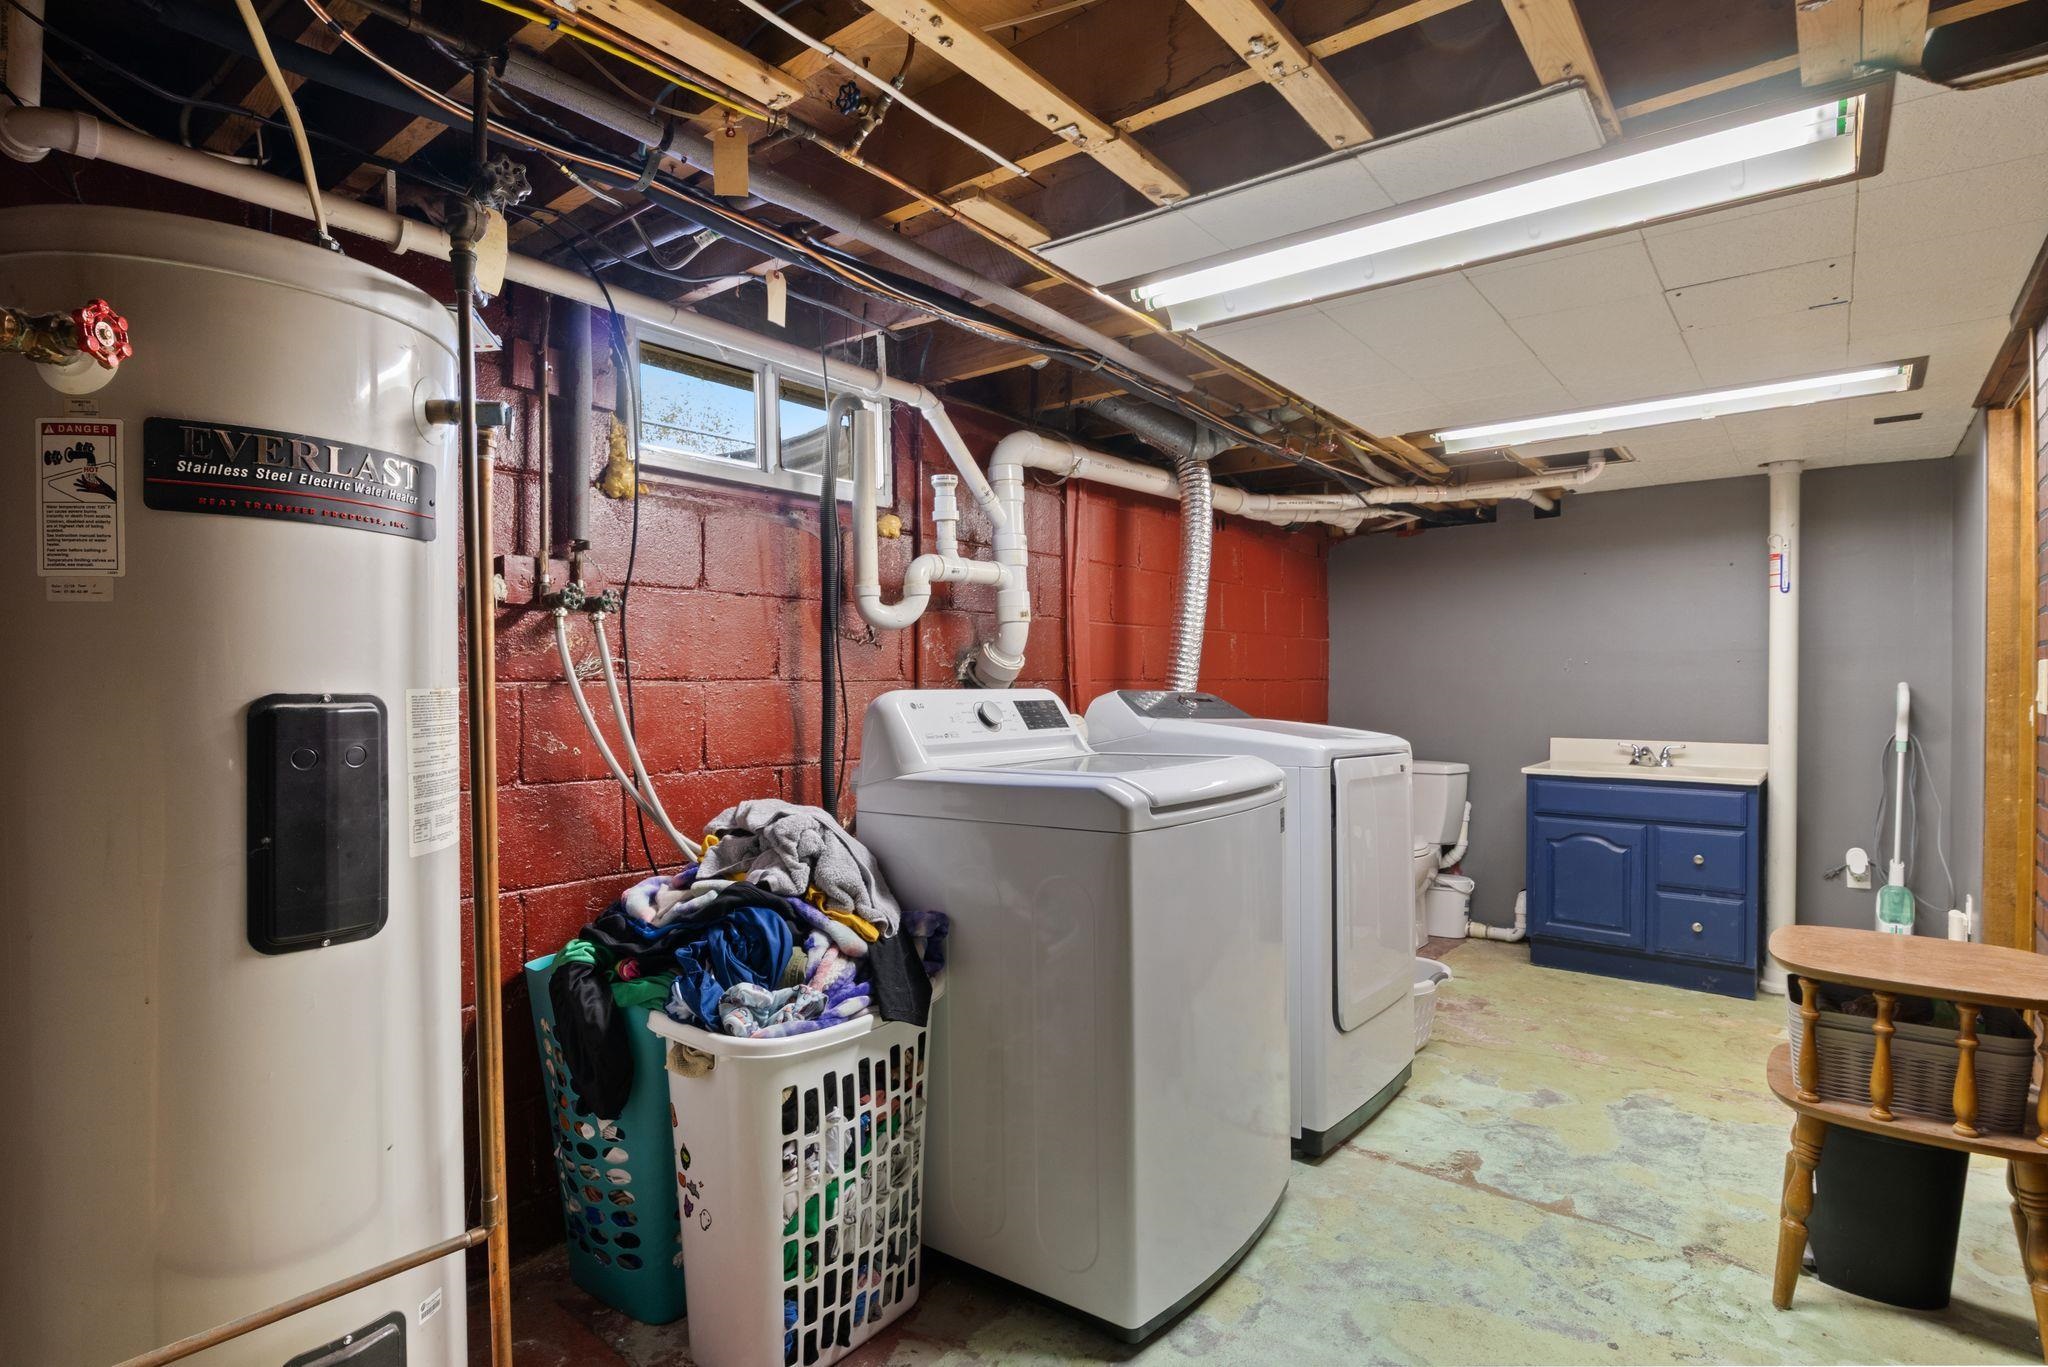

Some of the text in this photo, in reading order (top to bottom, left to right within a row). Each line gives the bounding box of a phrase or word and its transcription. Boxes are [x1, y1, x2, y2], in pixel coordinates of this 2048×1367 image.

[58, 425, 109, 434] DANGER
[177, 425, 420, 493] EVERLAST
[177, 460, 419, 504] Stainless Steel Electric Water Heater
[198, 497, 410, 530] HEAT TRANSFER PRODUCTS, INC.
